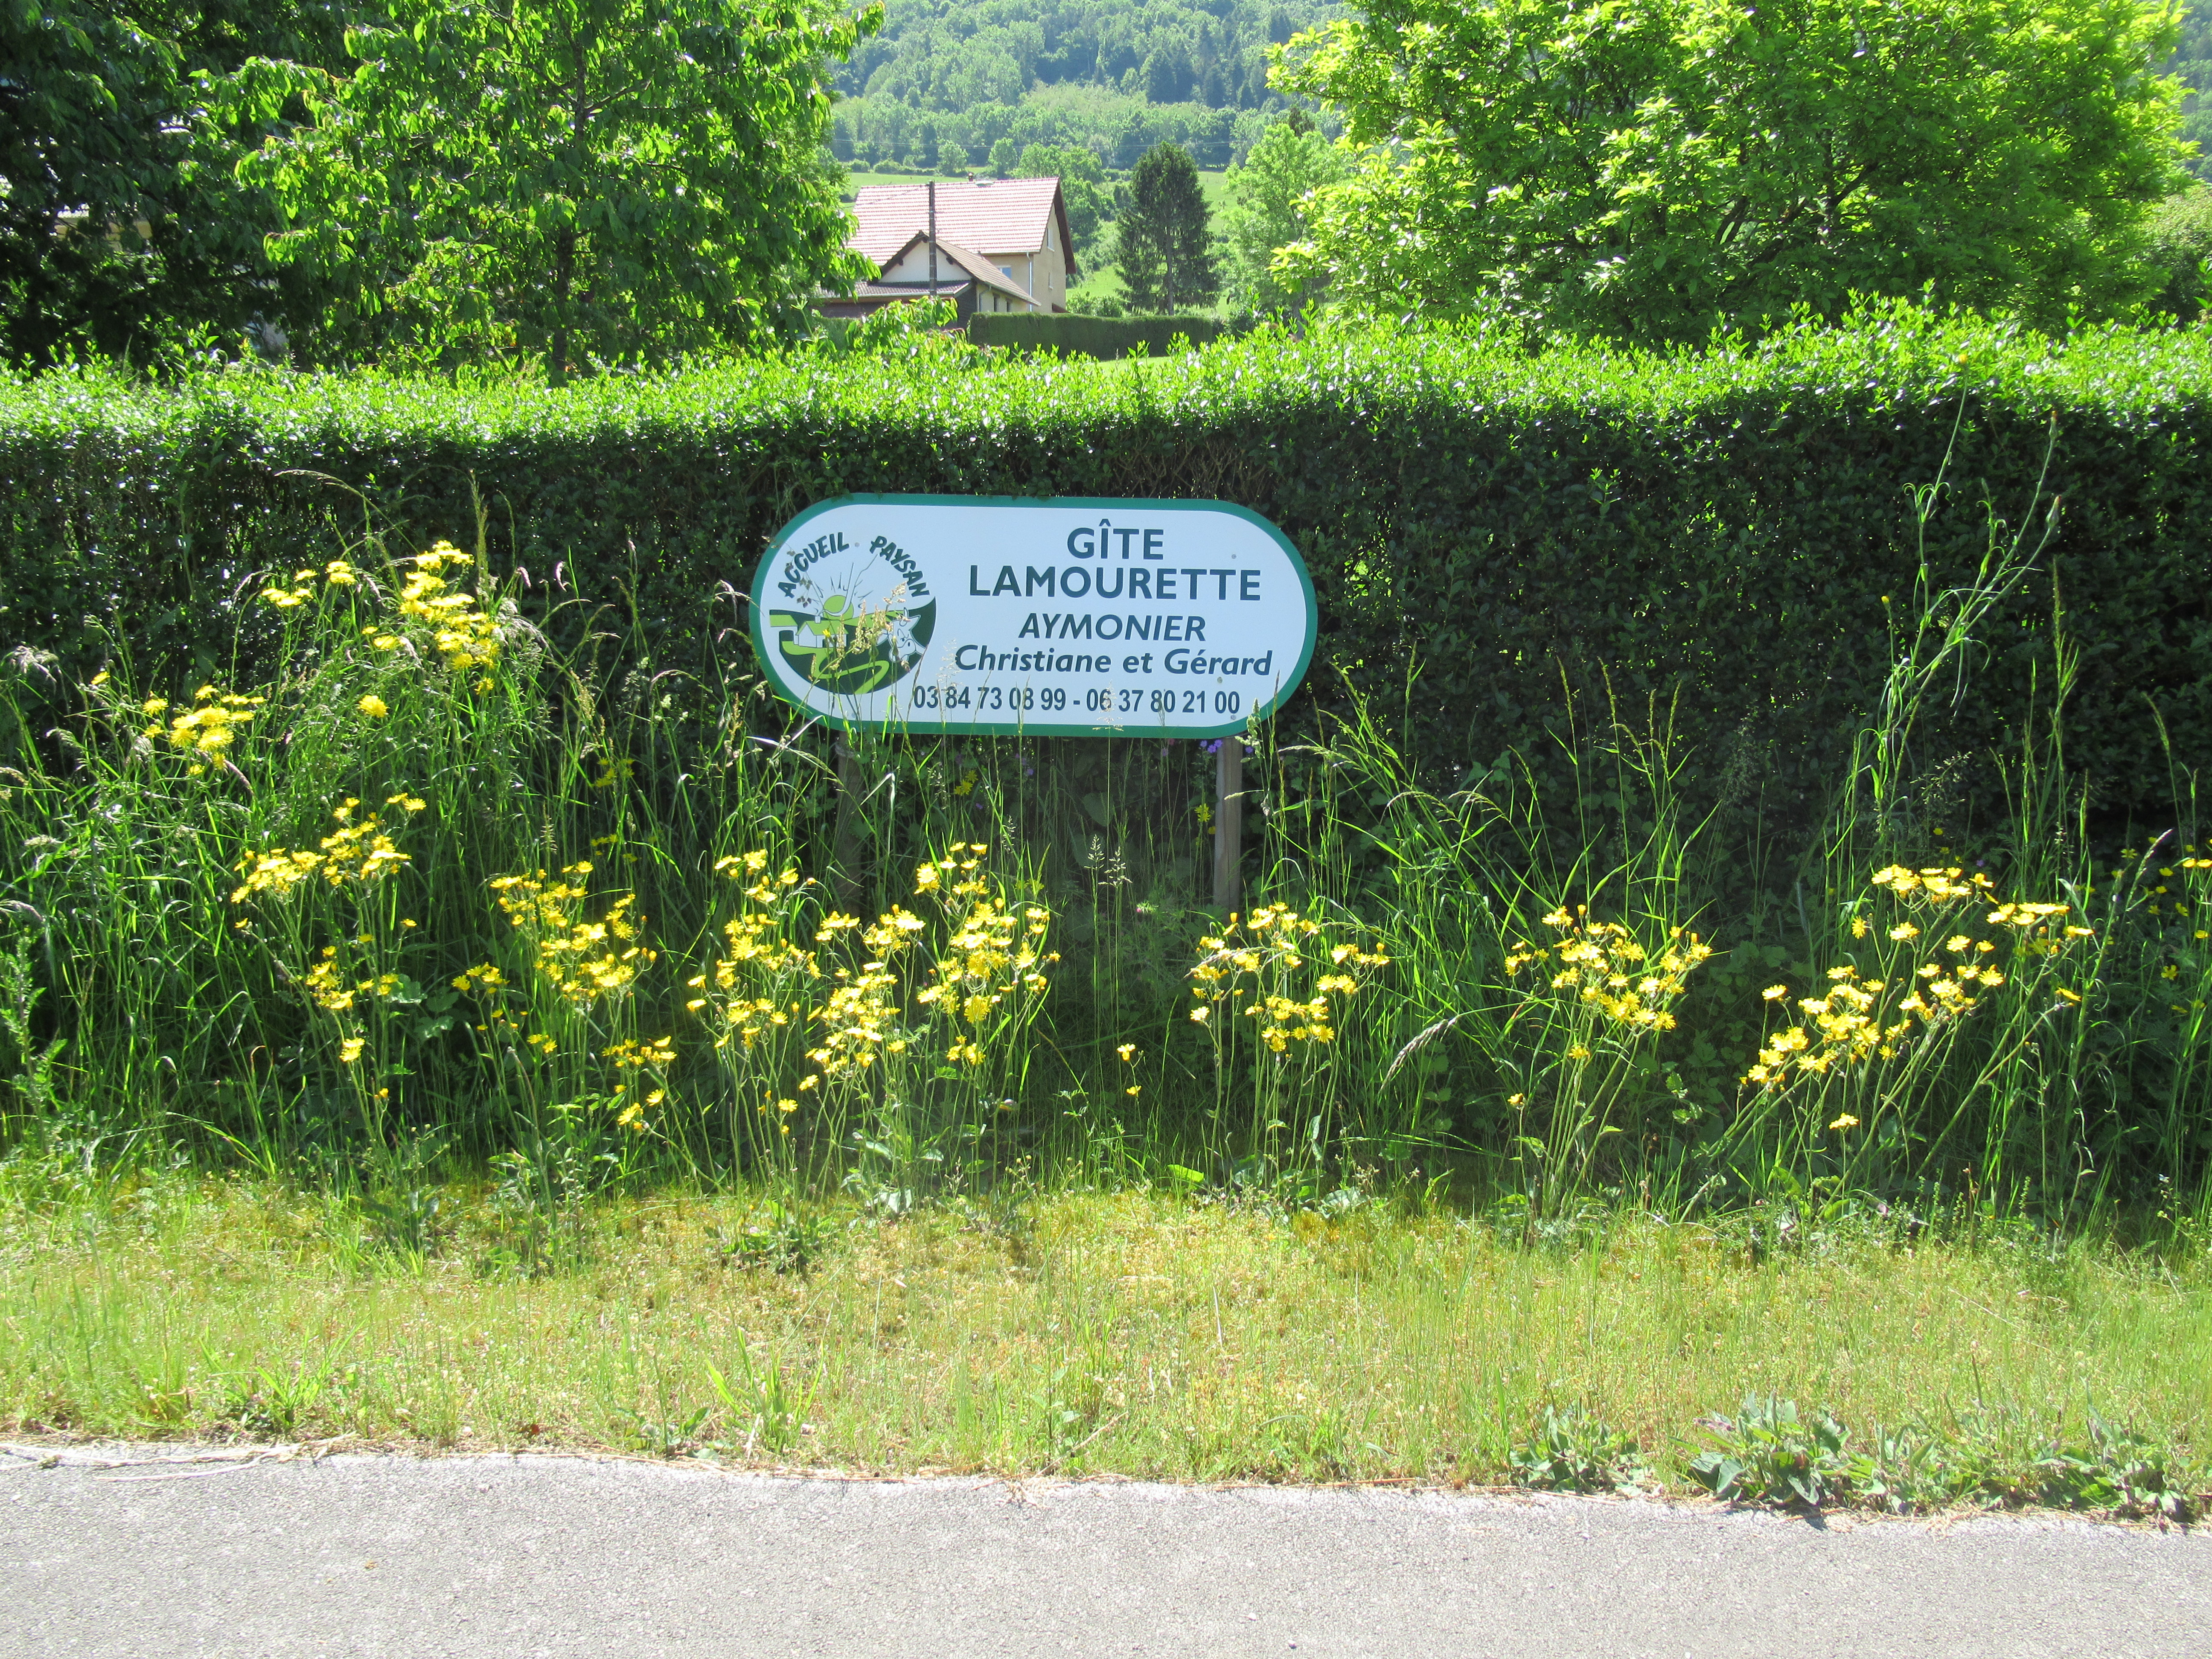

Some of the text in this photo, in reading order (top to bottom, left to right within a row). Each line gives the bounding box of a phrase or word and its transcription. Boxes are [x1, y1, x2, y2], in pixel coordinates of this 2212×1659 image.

[1067, 518, 1164, 560] GÎTE
[778, 532, 930, 598] ACCUEIL PAYSAN
[970, 565, 1261, 601] LAMOURETTE
[1018, 613, 1205, 641] AYMONIER
[955, 644, 1272, 675] Christiane et Gérard
[914, 686, 938, 709] 03
[946, 686, 971, 709] 84
[977, 687, 1002, 710] 73
[1009, 687, 1033, 710] 08
[1041, 688, 1066, 710] 99
[1086, 689, 1112, 711] 06
[1118, 690, 1144, 712] 37
[1150, 690, 1176, 713] 80
[1182, 691, 1206, 713] 21
[1214, 691, 1240, 713] 00
